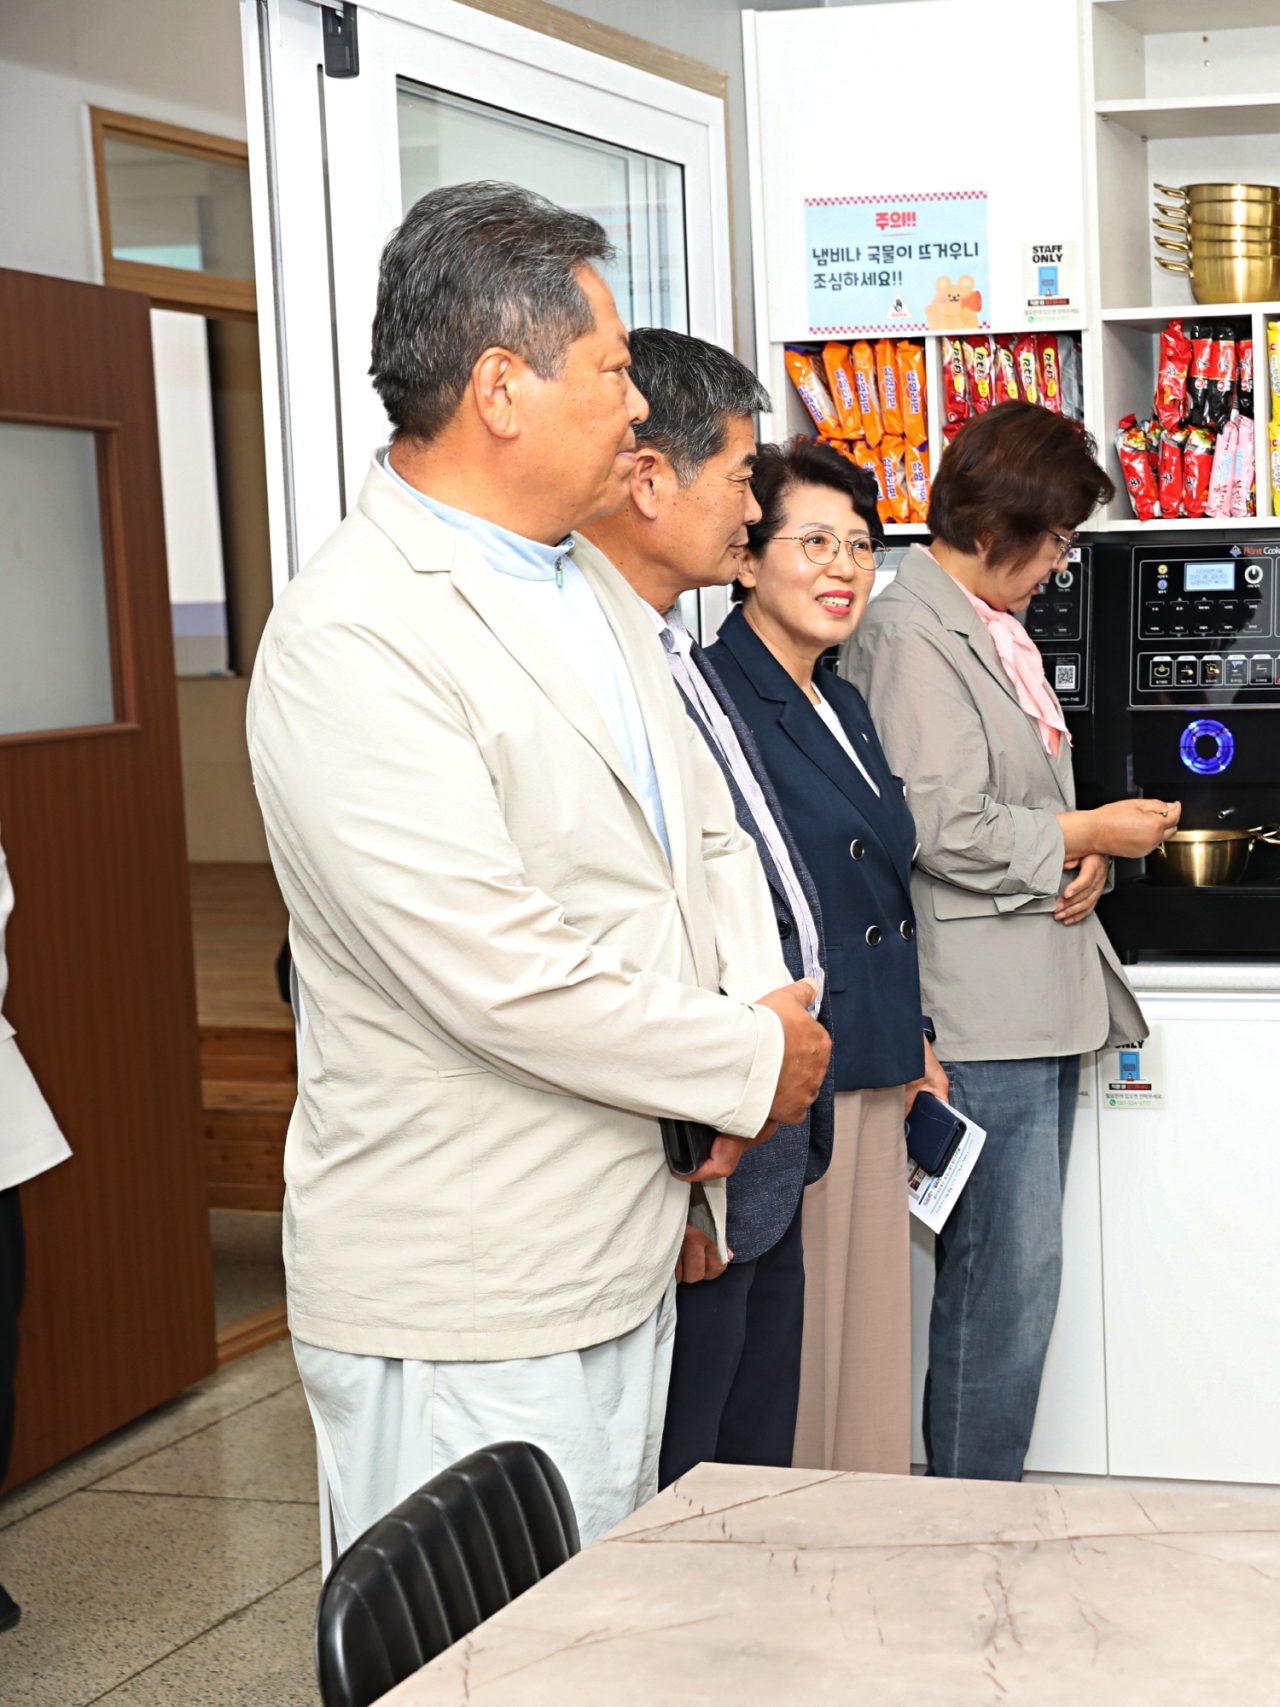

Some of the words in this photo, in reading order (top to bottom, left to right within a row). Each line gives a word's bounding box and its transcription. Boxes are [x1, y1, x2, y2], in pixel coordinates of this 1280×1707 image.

[876, 211, 917, 230] 주의!!
[812, 247, 861, 266] 냄비나
[867, 244, 912, 264] 국물이
[918, 242, 979, 260] 뜨거우니
[1032, 245, 1062, 253] STAFF
[1032, 254, 1063, 263] ONLY
[813, 271, 902, 291] 조심하세요!!
